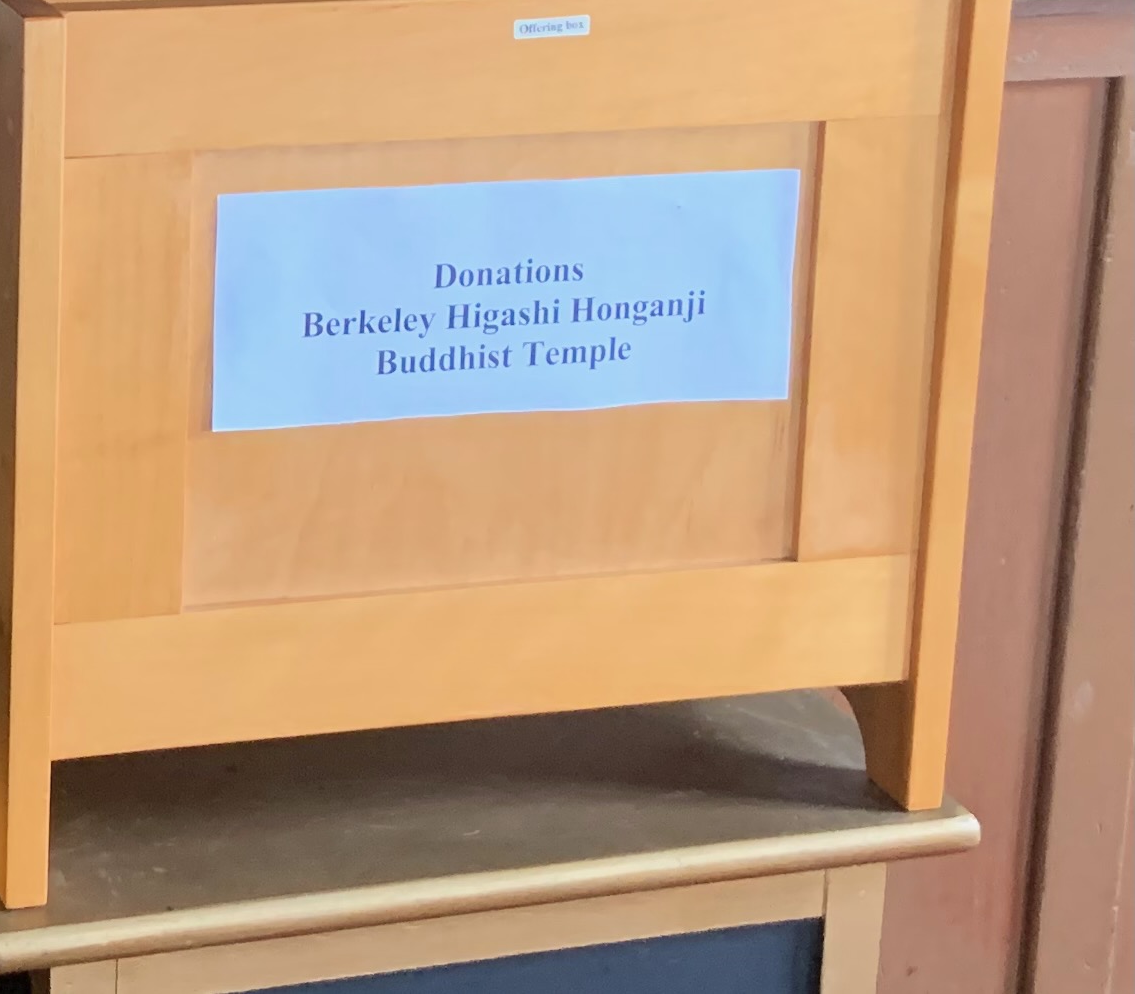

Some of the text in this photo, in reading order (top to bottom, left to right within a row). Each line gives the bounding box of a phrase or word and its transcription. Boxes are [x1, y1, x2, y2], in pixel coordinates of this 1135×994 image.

[518, 22, 564, 35] Offering
[434, 258, 584, 289] Donations
[302, 290, 706, 338] Berkeley Higashi Honganji
[377, 336, 632, 375] Buddhist Temple
